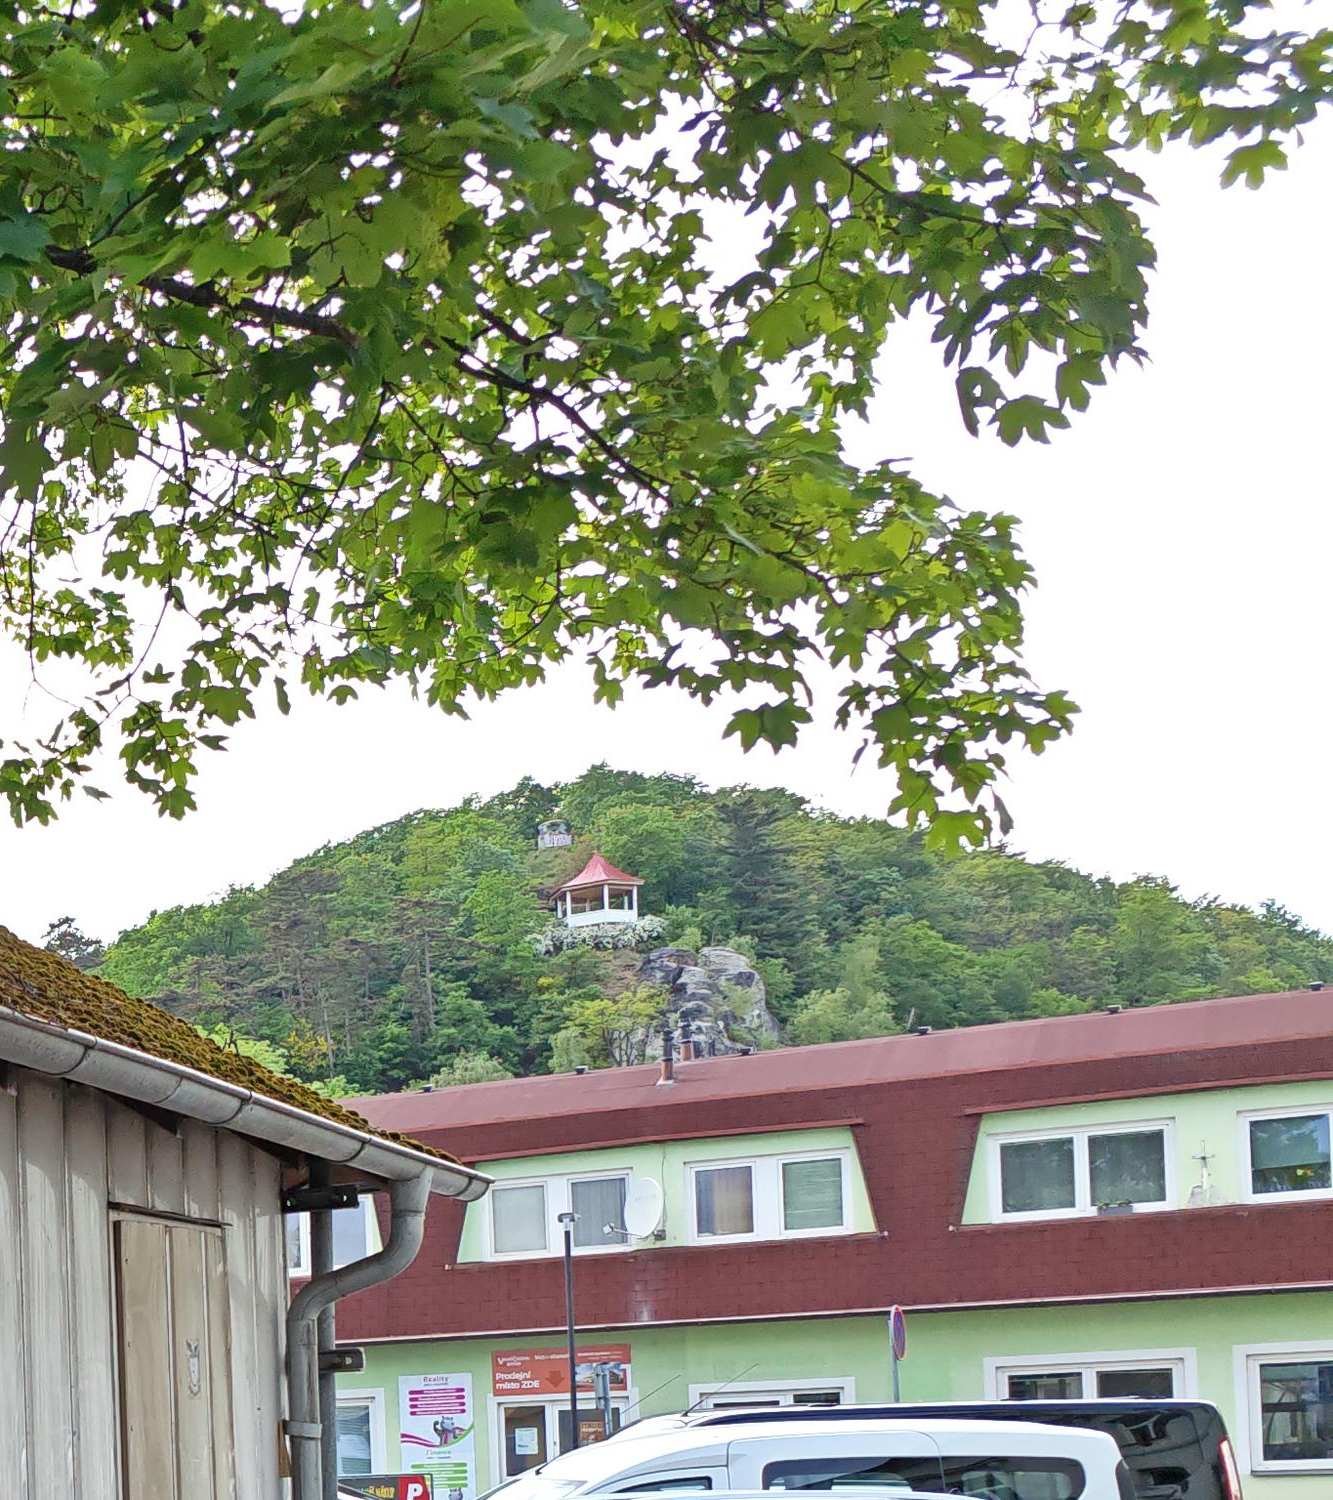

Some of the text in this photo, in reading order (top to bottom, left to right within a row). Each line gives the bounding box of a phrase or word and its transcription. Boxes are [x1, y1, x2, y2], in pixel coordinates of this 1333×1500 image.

[495, 1370, 531, 1381] Prodejní
[495, 1379, 540, 1390] místo ZDE
